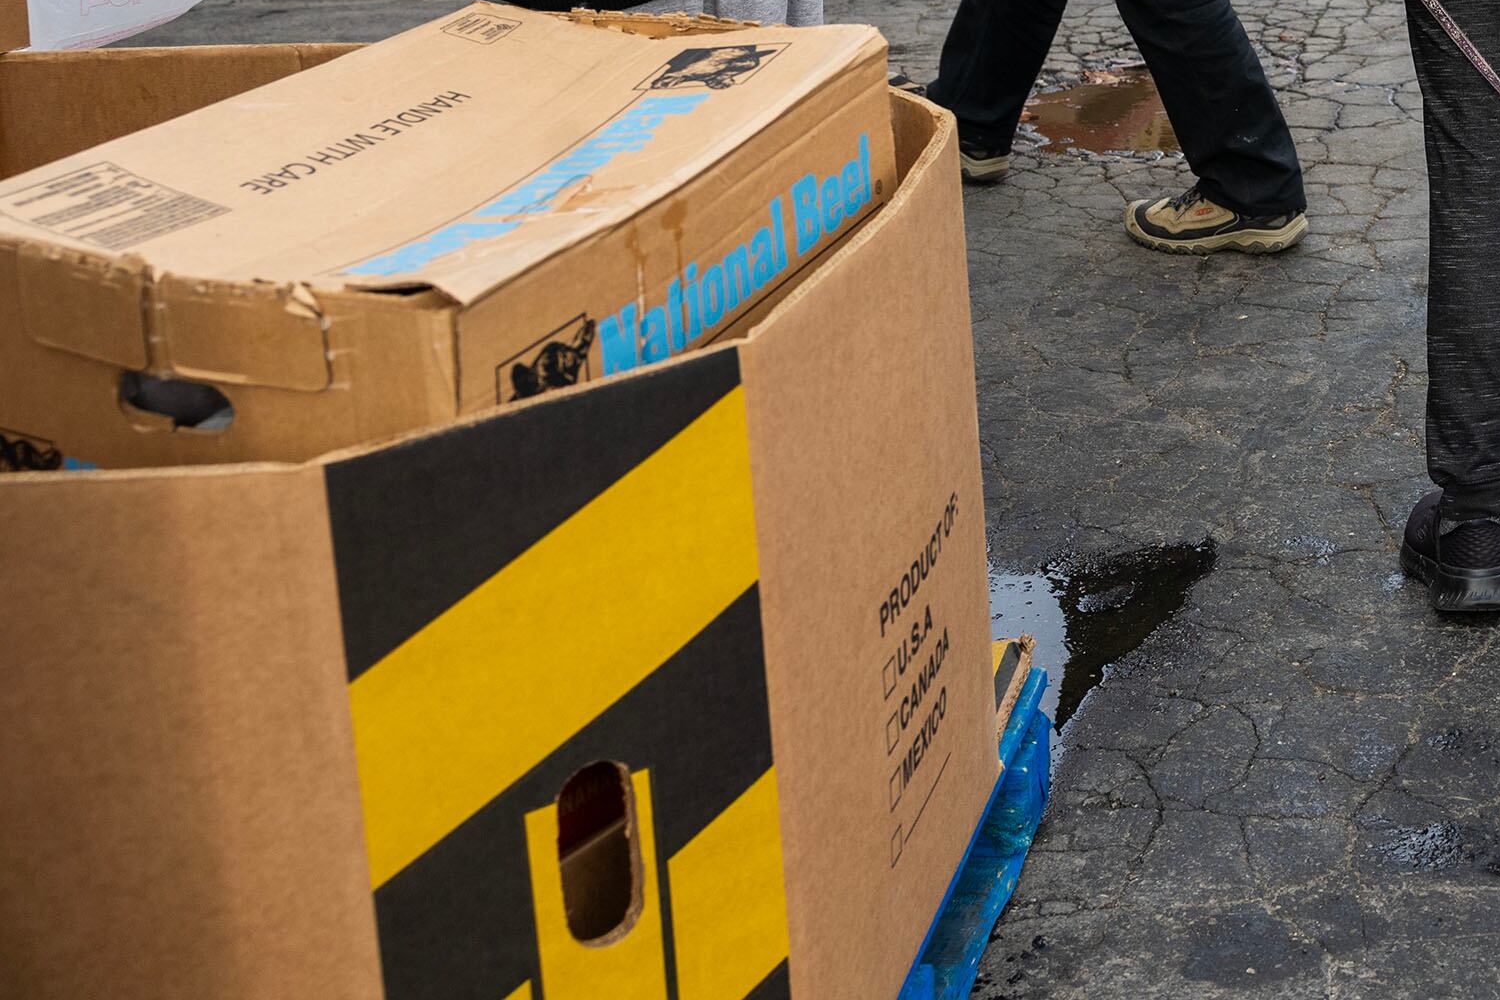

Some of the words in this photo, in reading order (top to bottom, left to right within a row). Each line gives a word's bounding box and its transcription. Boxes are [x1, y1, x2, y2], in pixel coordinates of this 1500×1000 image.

[307, 133, 386, 165] WITH
[370, 90, 472, 136] HANDLE
[240, 162, 317, 195] CARE
[597, 195, 789, 378] National
[791, 132, 873, 257] Beef
[879, 519, 943, 639] PRODUCT
[897, 604, 933, 676] U.S.A
[901, 626, 950, 731] CANADA
[902, 685, 947, 790] MEXICO
